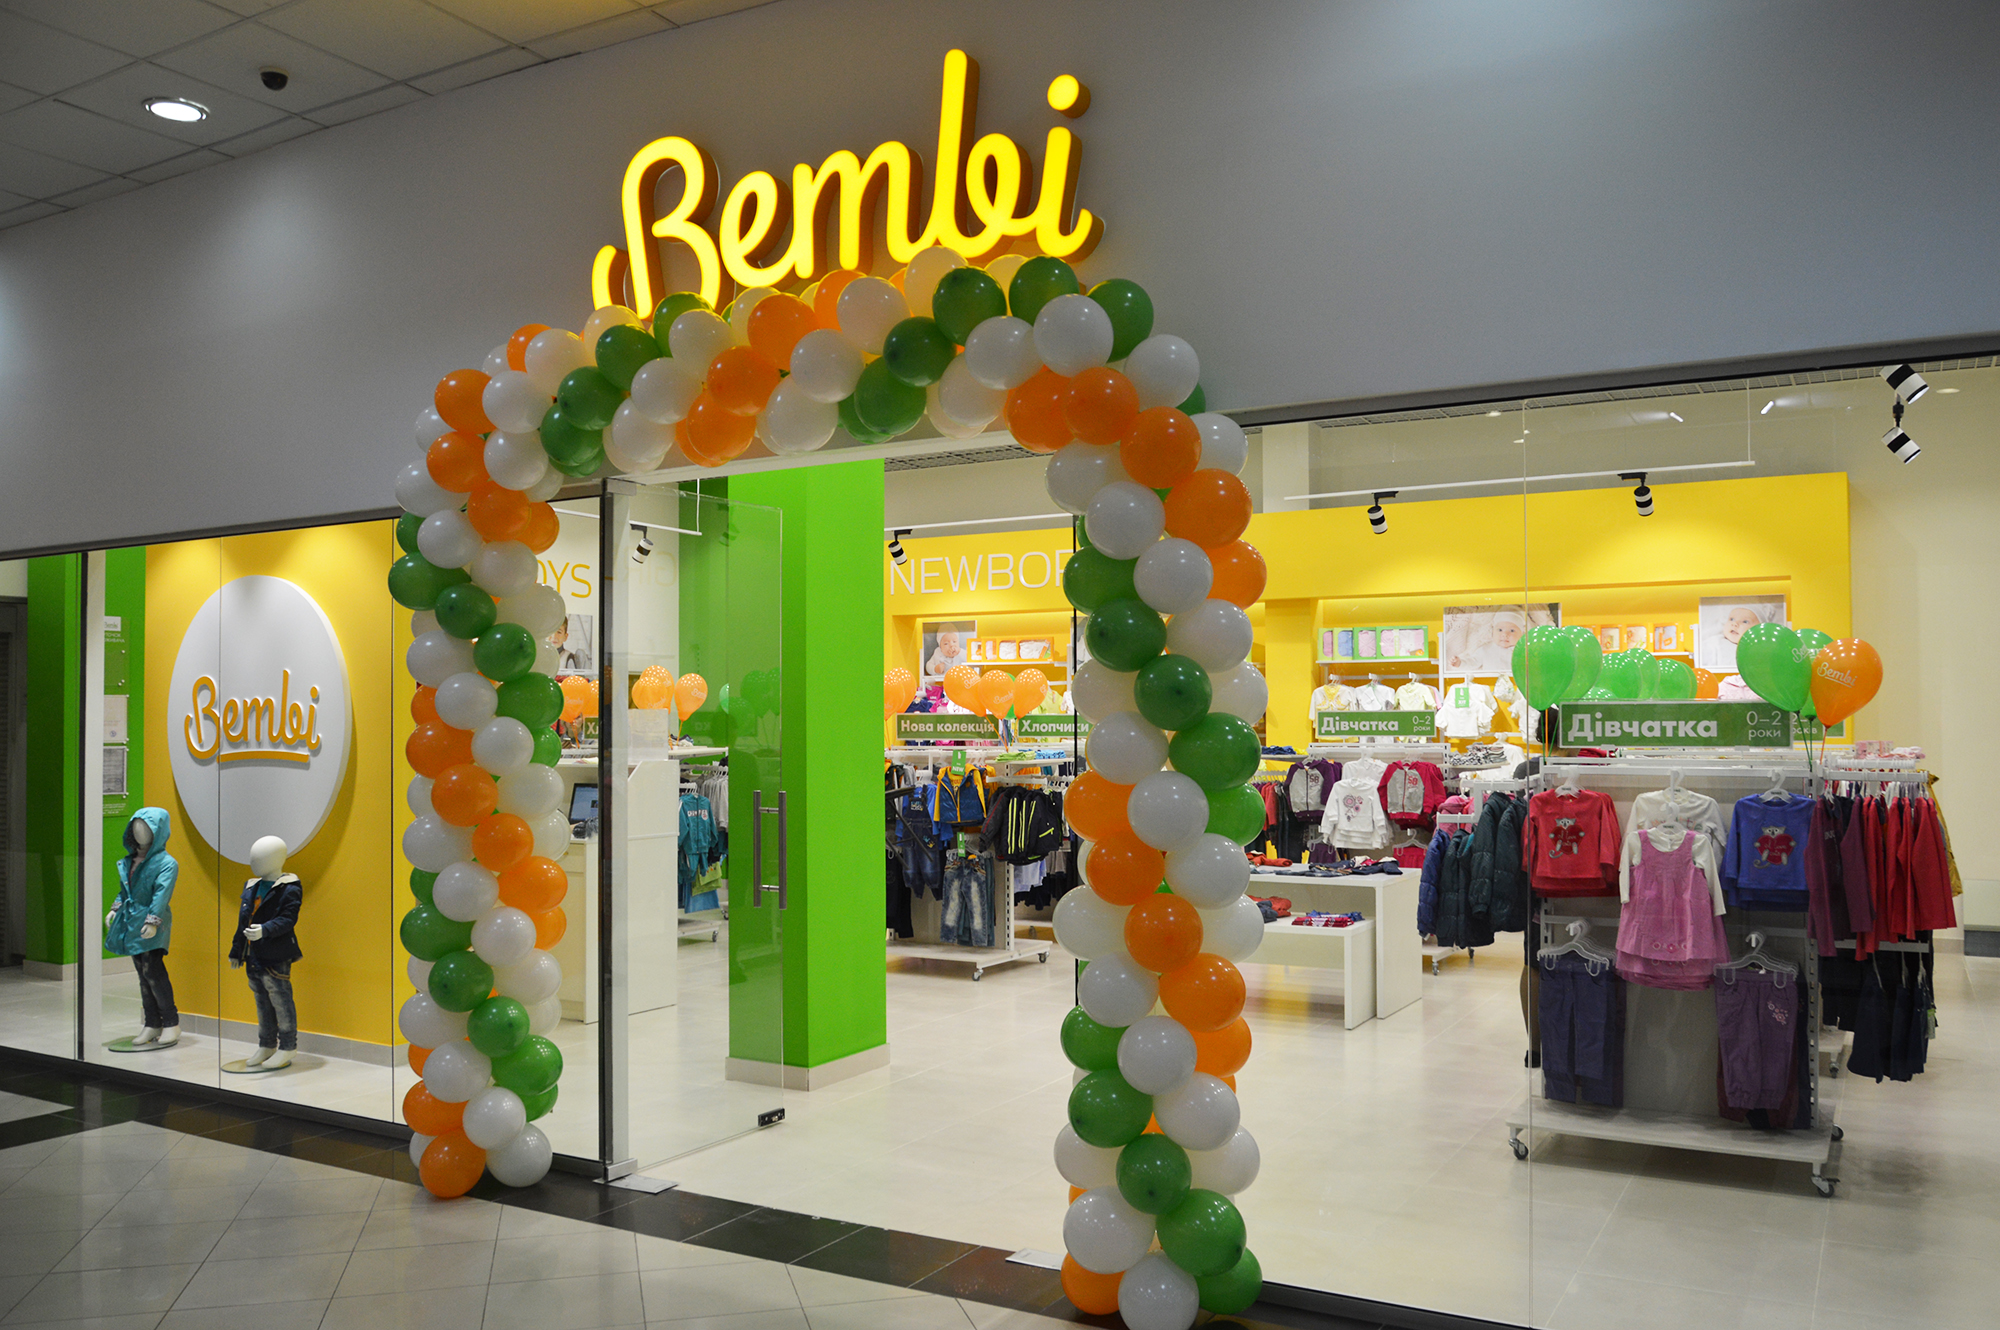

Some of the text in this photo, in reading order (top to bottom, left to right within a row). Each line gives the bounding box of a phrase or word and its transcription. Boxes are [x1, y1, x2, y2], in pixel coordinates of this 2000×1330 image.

[592, 49, 1103, 321] Bembi
[1817, 661, 1858, 686] Bembi
[184, 669, 321, 760] Bembi
[1321, 716, 1399, 734] Дівчатка
[900, 719, 995, 735] Нова колекція
[1413, 725, 1431, 733] роки
[1568, 713, 1718, 744] Дівчатка
[1748, 728, 1782, 742] роки
